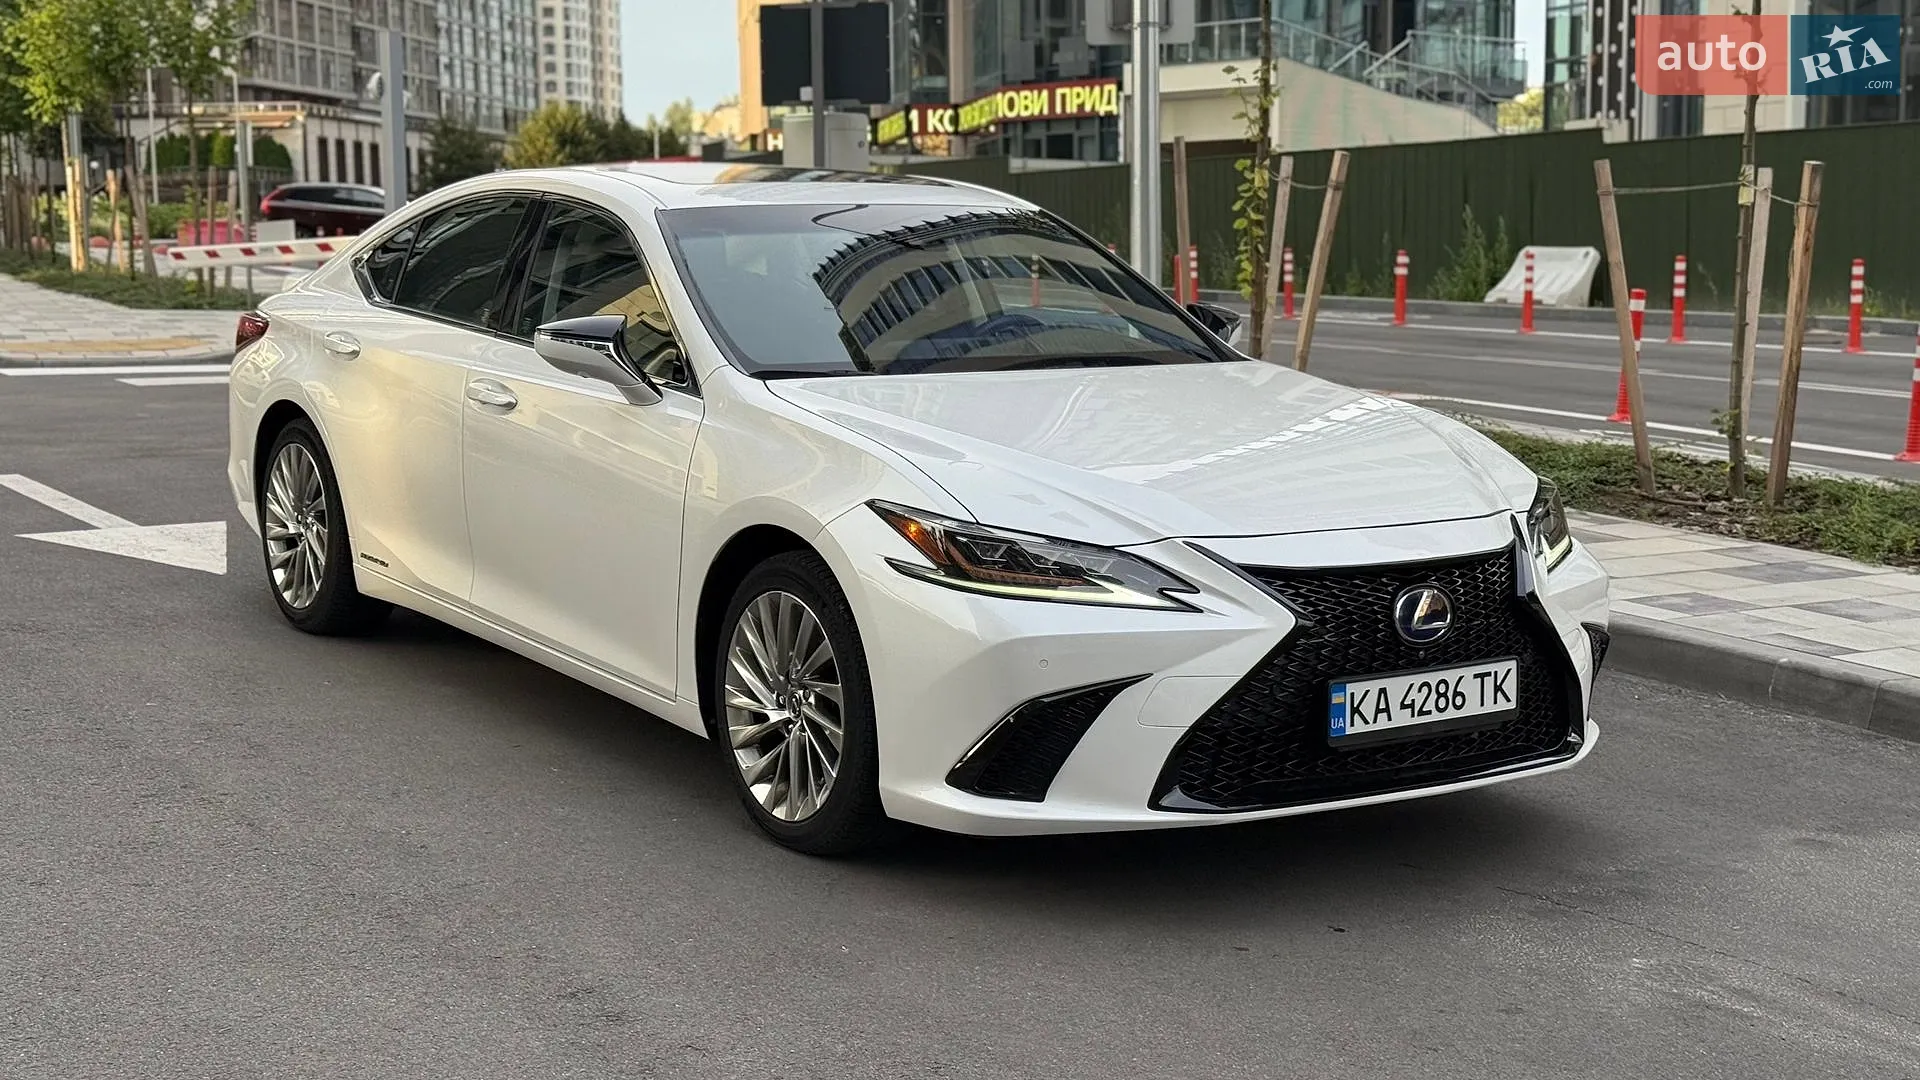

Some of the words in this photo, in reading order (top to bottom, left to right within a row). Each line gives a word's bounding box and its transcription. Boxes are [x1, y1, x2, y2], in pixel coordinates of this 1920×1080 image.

[1055, 83, 1118, 117] ПРИД
[1350, 687, 1392, 727] KA
[1400, 675, 1466, 718] 4286
[1473, 668, 1513, 707] TK
[1331, 718, 1344, 729] UA
